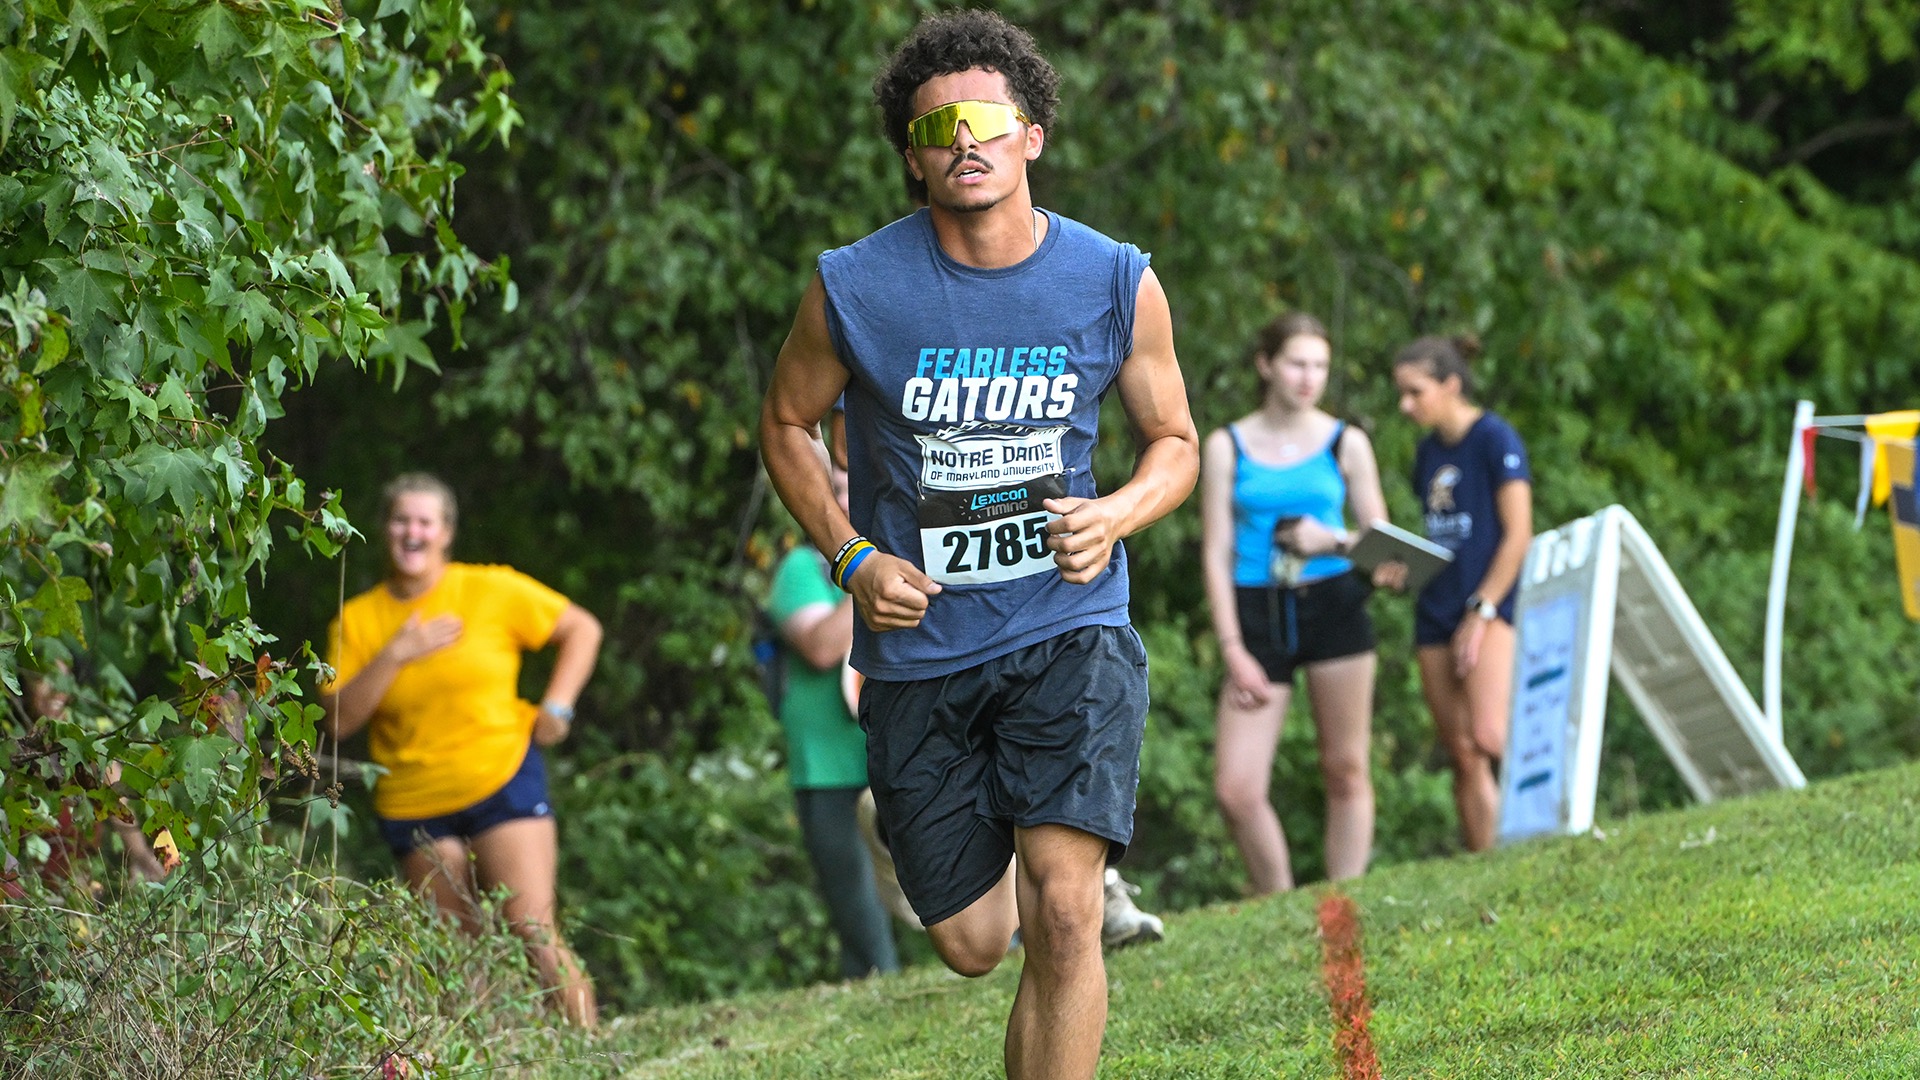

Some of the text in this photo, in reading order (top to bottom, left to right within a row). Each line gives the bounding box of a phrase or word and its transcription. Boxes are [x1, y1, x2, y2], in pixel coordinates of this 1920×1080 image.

[916, 346, 1068, 380] FEARLESS
[902, 374, 1079, 422] GATORS
[930, 443, 1054, 468] NOTRE DAME
[930, 462, 1055, 482] OF MARYLAND UNIVERSITY
[979, 500, 1029, 518] TIMING
[942, 516, 1051, 574] 2785
